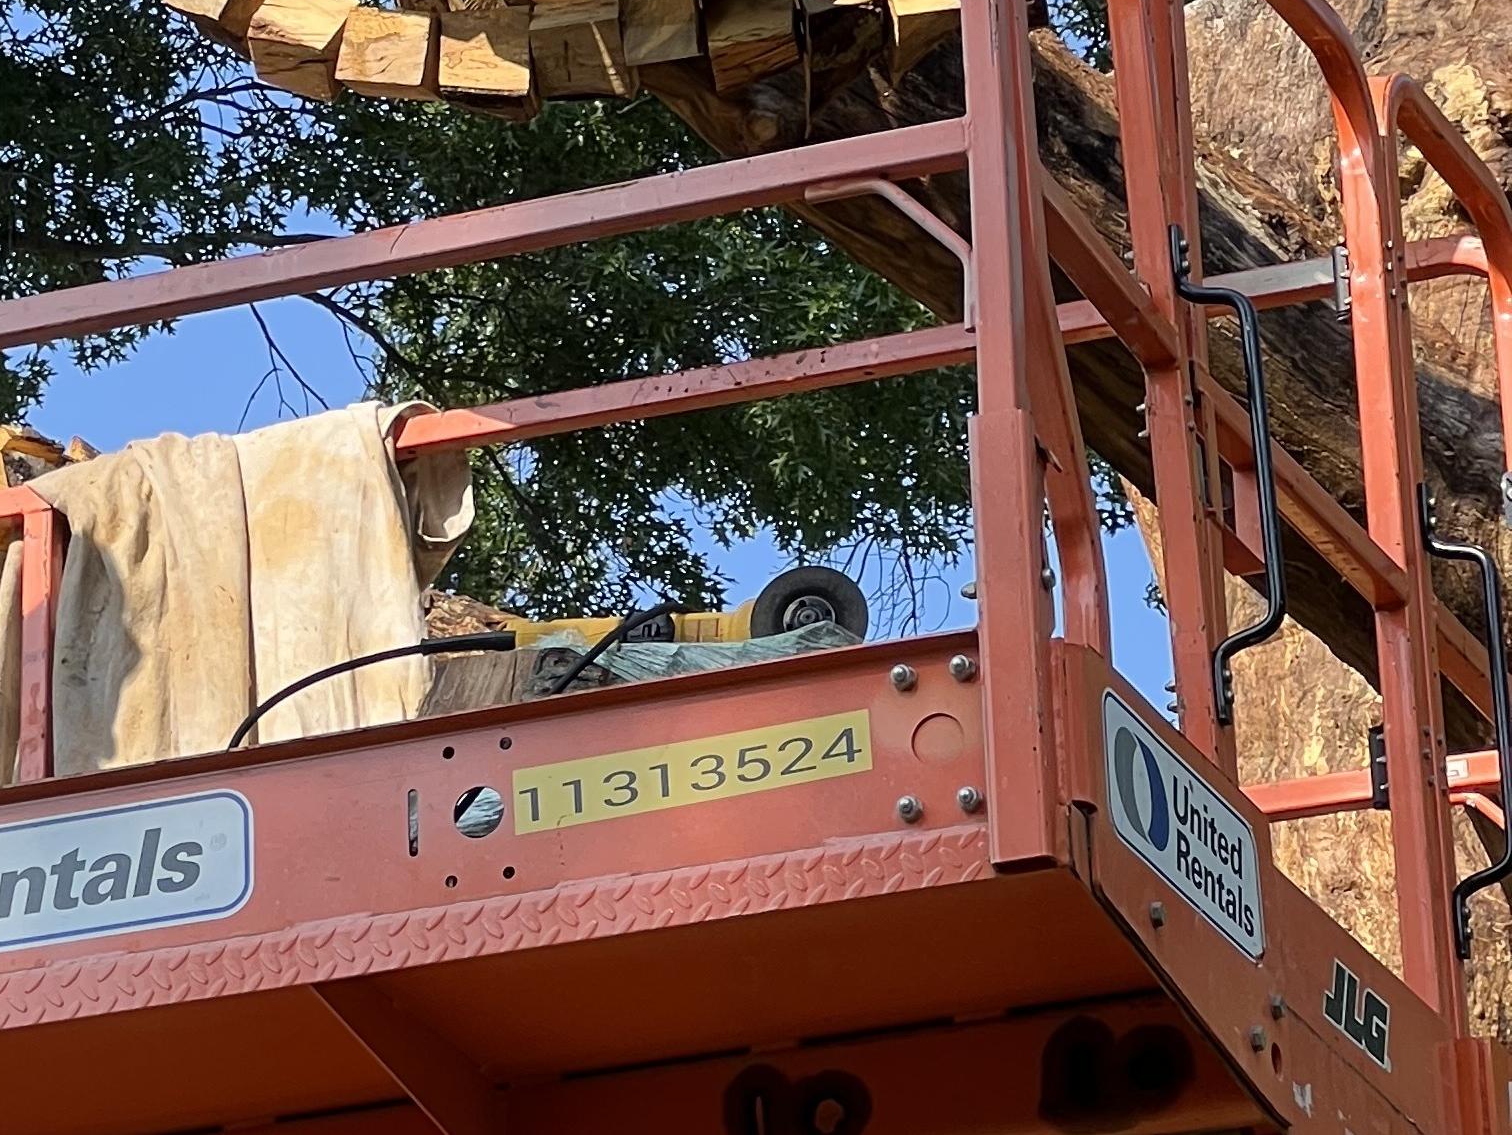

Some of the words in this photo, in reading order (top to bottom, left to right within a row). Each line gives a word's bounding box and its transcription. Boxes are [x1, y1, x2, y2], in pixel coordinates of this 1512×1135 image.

[518, 726, 863, 823] 11313524
[1172, 774, 1244, 880] United
[1176, 827, 1255, 938] Rentals
[1324, 958, 1390, 1069] JLG
